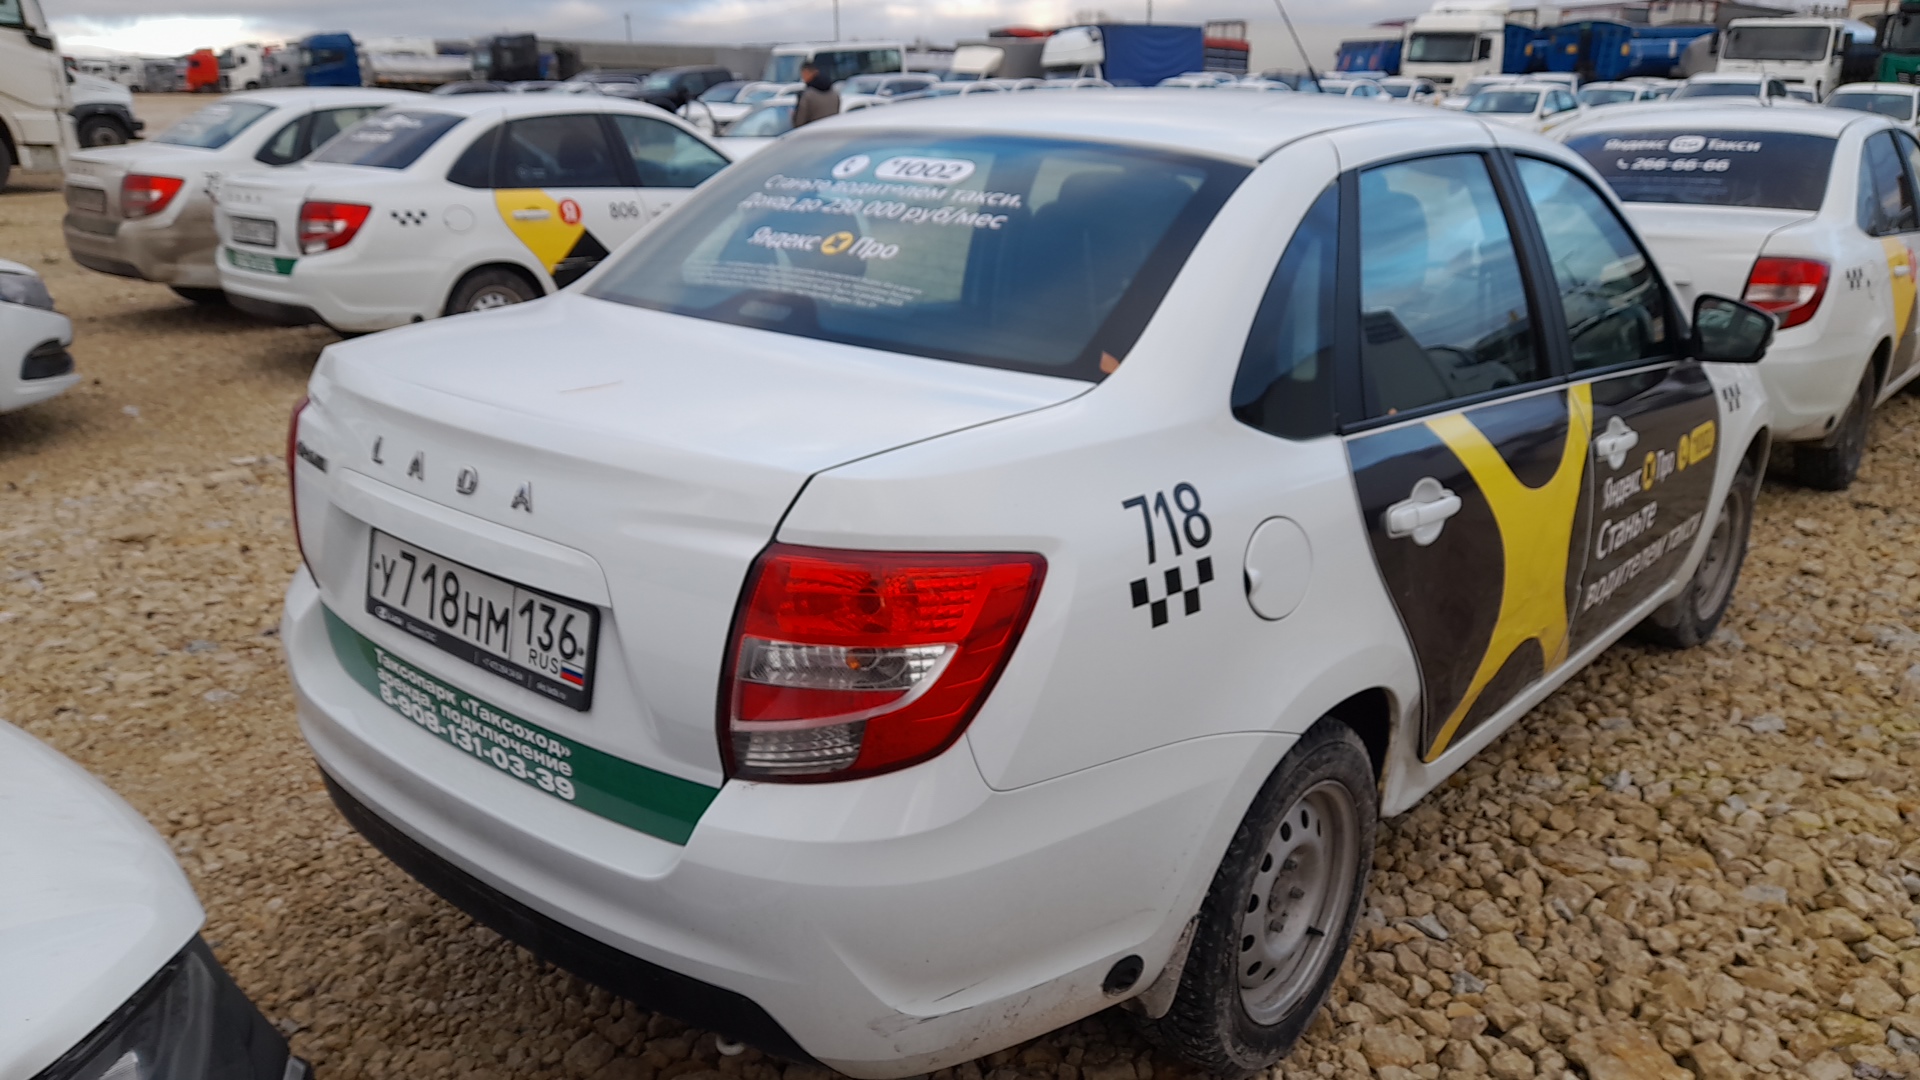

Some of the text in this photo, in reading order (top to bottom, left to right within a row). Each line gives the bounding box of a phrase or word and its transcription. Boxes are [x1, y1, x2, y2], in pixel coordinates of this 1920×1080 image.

[609, 202, 639, 219] 806
[848, 236, 899, 260] Про
[371, 435, 533, 514] LADA
[1121, 481, 1212, 566] 718
[1596, 500, 1657, 560] Станьте
[519, 599, 577, 660] 136
[374, 647, 457, 705] Таксопарк
[528, 648, 559, 675] RUS
[379, 682, 576, 801] 8-908-131-03-39
[440, 704, 573, 777] подключение
